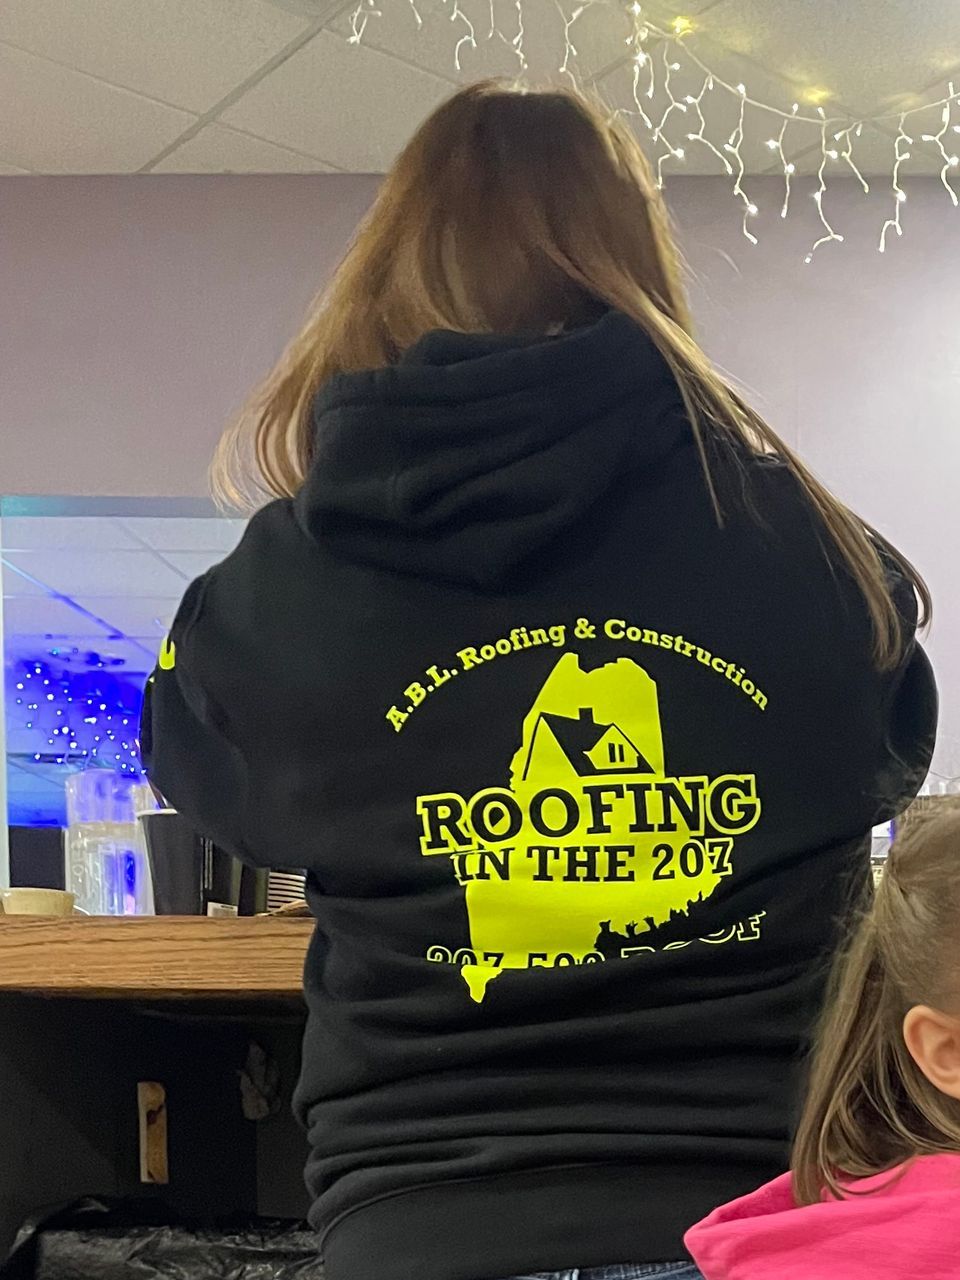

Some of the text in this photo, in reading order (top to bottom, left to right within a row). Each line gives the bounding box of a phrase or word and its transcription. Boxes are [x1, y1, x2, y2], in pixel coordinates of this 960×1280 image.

[386, 618, 769, 732] A.B.L. Roofing & Construction
[417, 775, 761, 855] ROOFING
[451, 838, 733, 884] IN THE 207
